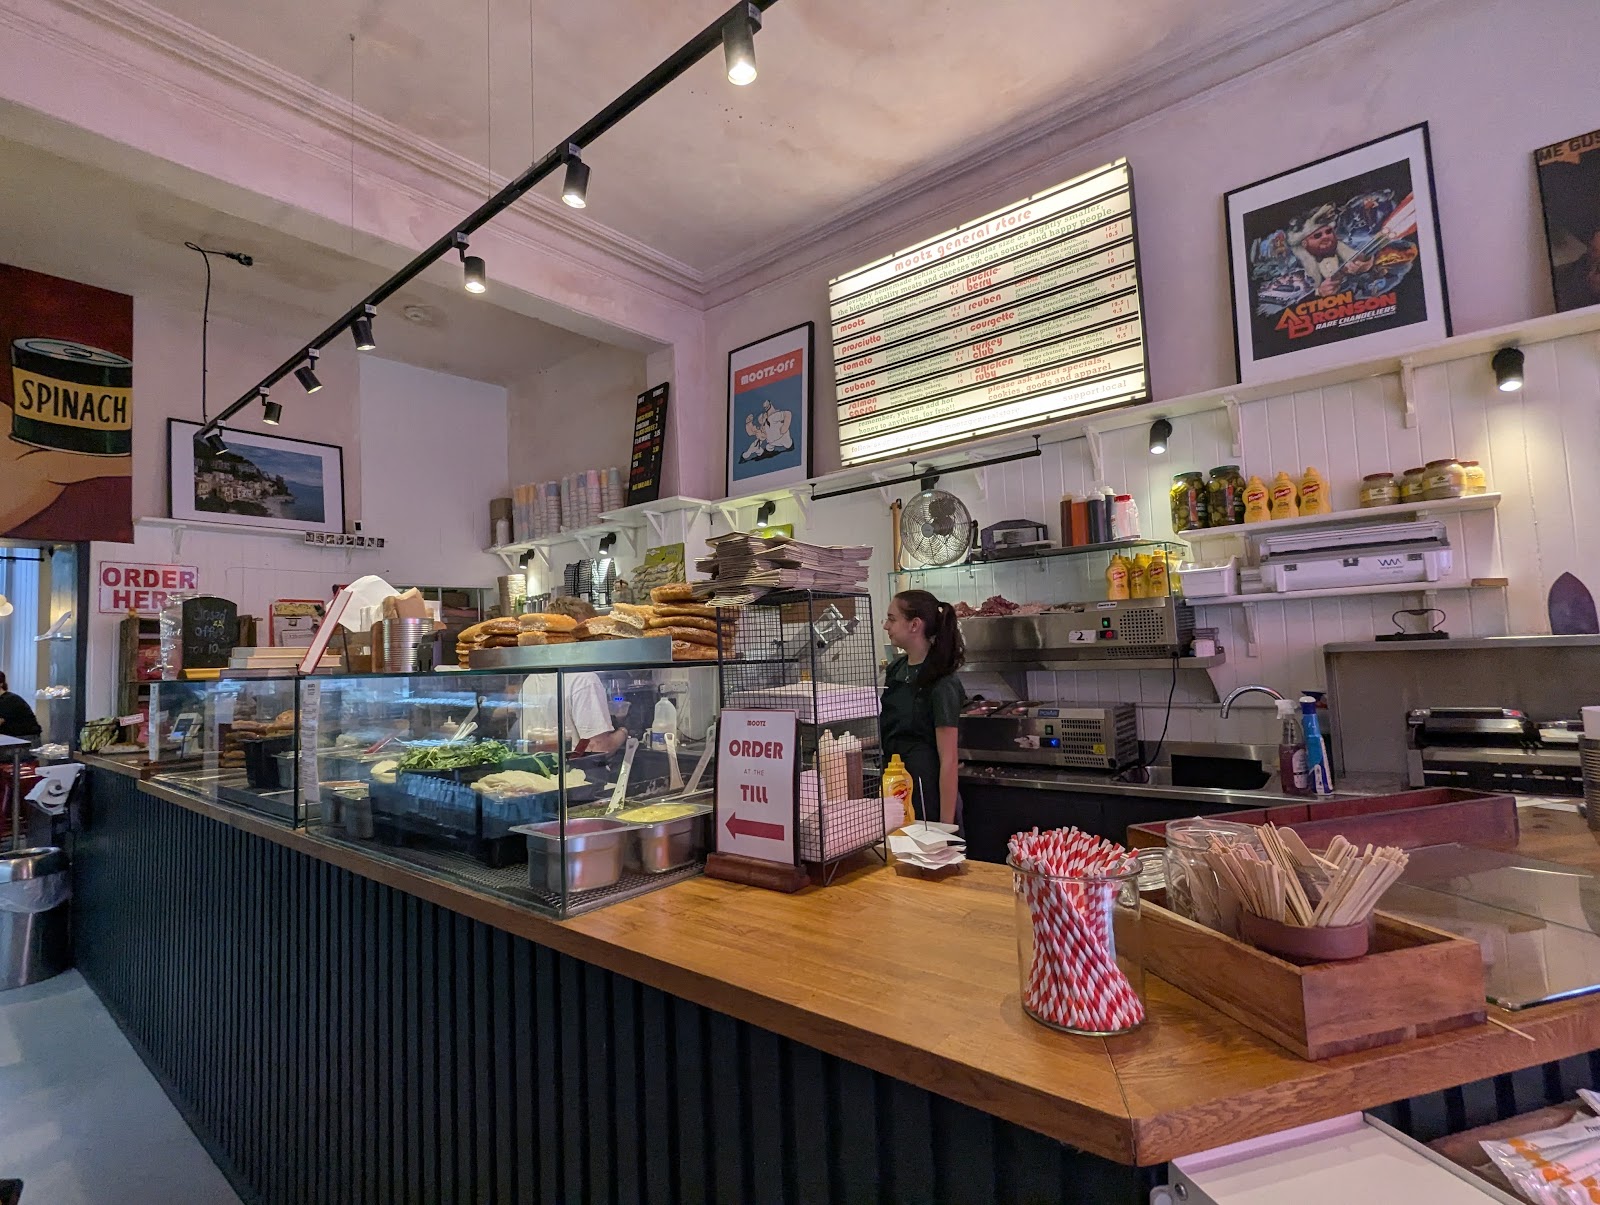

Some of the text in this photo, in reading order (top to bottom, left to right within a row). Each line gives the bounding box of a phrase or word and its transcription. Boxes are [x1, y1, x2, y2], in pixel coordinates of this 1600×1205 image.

[894, 210, 1031, 271] mootz general store
[845, 290, 872, 305] lovingly
[874, 276, 911, 295] homemade
[913, 259, 955, 280] schiacciata
[957, 255, 964, 263] in
[967, 245, 995, 260] regular
[998, 236, 1014, 248] size
[1027, 219, 1061, 236] slightly
[1064, 204, 1103, 222] smaller,
[849, 297, 873, 312] highest
[874, 289, 898, 302] quality
[900, 281, 922, 293] meats
[923, 273, 937, 284] and
[939, 263, 969, 278] cheeses
[971, 258, 981, 266] we
[984, 252, 998, 261] can
[1000, 240, 1028, 255] source
[1031, 232, 1047, 243] and
[1049, 221, 1076, 237] happy
[1080, 208, 1115, 226] people.
[966, 265, 1000, 284] huckle-
[966, 277, 991, 291] berry
[968, 294, 1001, 310] reuben
[1275, 291, 1353, 331] ACTION
[840, 318, 865, 332] mootz
[970, 312, 1014, 331] courgette
[1288, 292, 1397, 339] BRONSON
[1315, 319, 1338, 330] RARE
[1339, 305, 1397, 324] CHANDELIERS
[841, 335, 881, 355] prosciutto
[972, 335, 1002, 351] turkey
[972, 346, 993, 358] club
[740, 358, 796, 386] MOOTZ-OFF
[843, 357, 872, 371] tomato
[974, 356, 1013, 373] chicken
[975, 370, 996, 383] ruby
[987, 355, 1104, 394] please ask about specials,
[1026, 379, 1052, 392] goods
[1054, 372, 1071, 383] and
[1074, 362, 1111, 380] apparel
[844, 379, 875, 393] cubano
[1062, 379, 1126, 401] support local
[20, 380, 127, 423] SPINACH
[848, 397, 876, 410] salmon
[858, 412, 895, 427] remember,
[897, 409, 909, 418] you
[925, 400, 939, 408] add
[941, 396, 953, 404] hot
[858, 425, 878, 434] honey
[935, 404, 954, 414] free!!
[102, 567, 195, 589] ORDER
[1075, 632, 1084, 640] 2
[729, 740, 783, 759] ORDER
[741, 784, 768, 803] TILL
